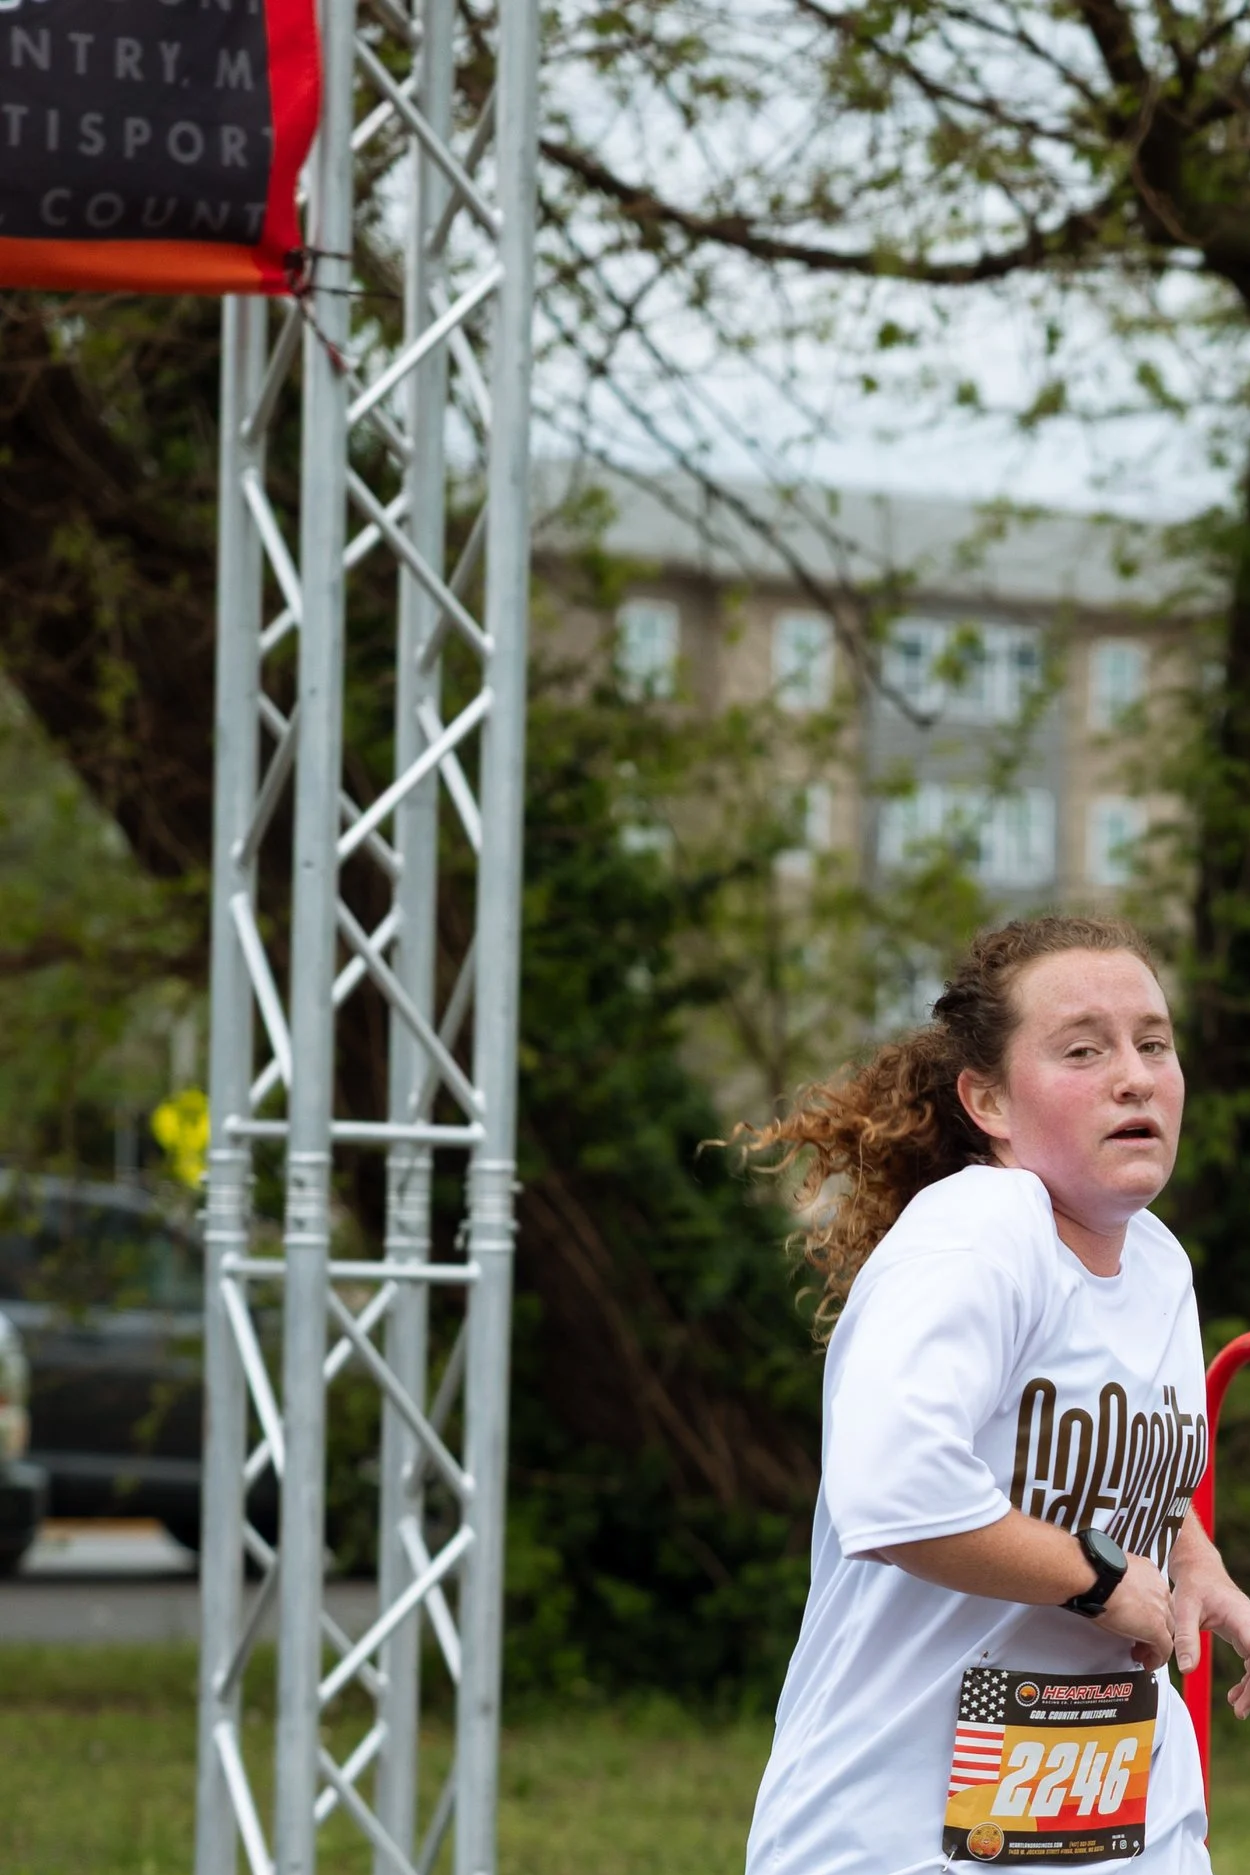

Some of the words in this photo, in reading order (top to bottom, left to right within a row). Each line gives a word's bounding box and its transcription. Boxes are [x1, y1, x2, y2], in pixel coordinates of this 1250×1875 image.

[1041, 1682, 1133, 1700] HEARTLAND
[1029, 1710, 1047, 1720] GOD.
[989, 1737, 1138, 1817] 2246
